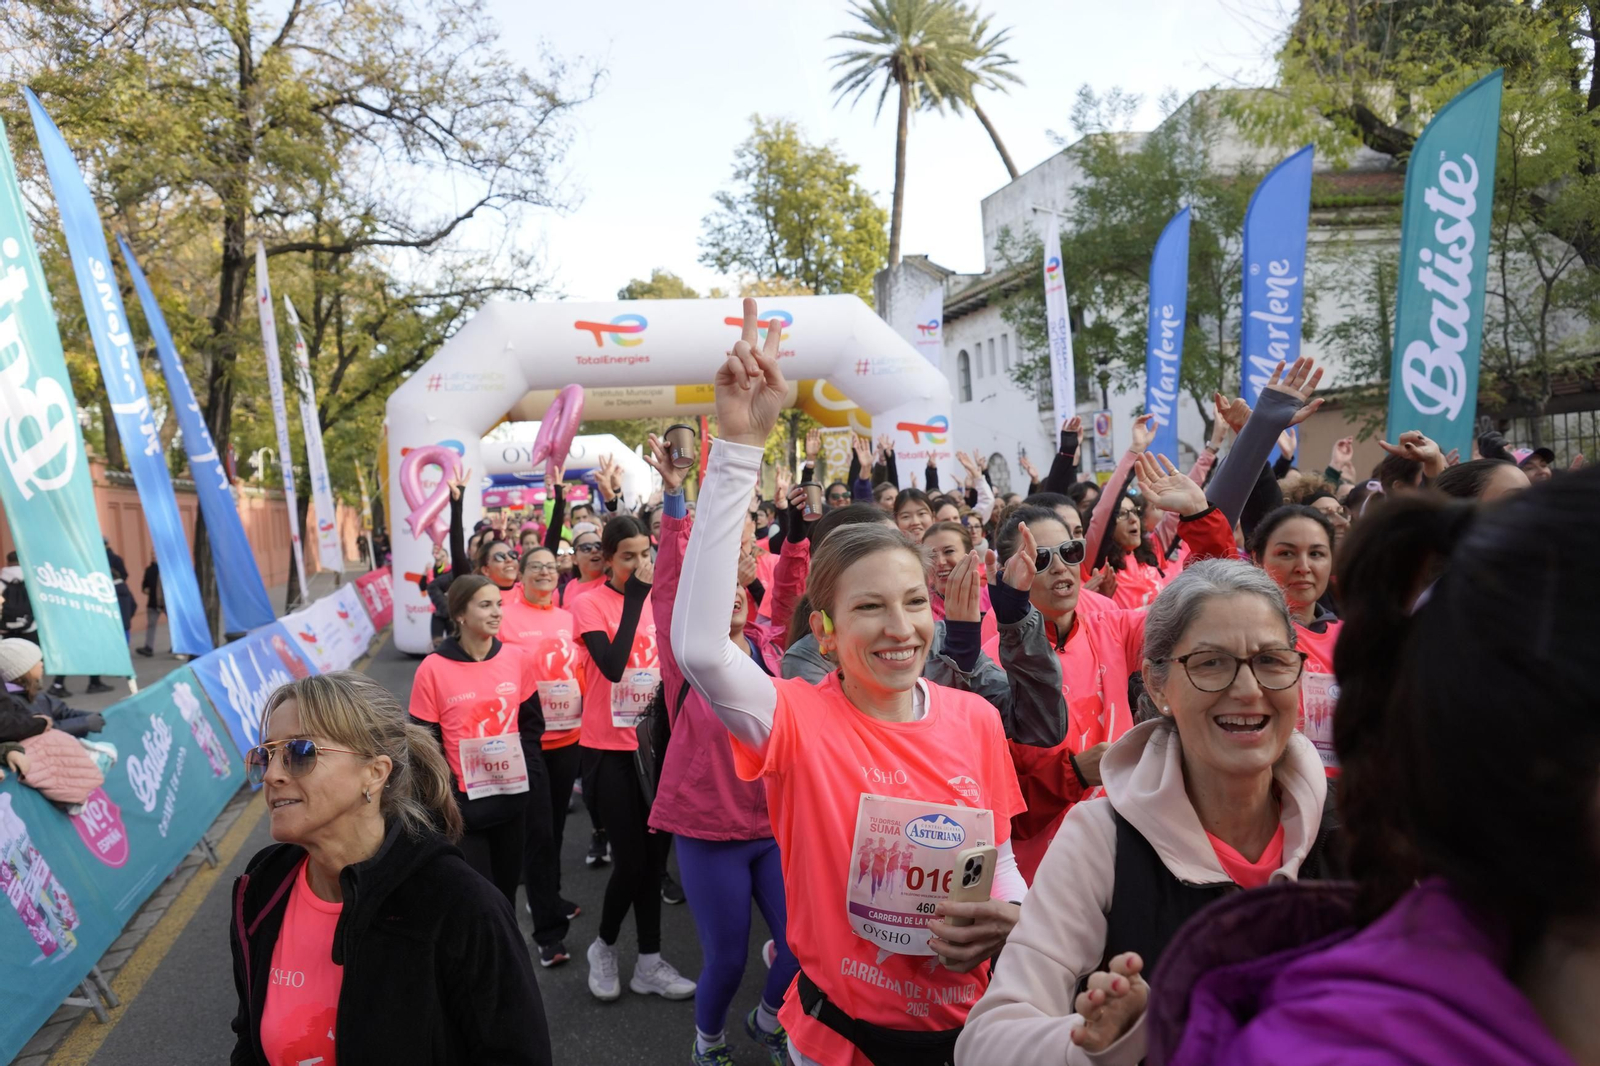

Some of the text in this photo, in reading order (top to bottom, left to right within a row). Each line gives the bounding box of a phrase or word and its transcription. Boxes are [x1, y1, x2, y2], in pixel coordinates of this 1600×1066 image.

[1402, 152, 1479, 421] Batiste
[575, 354, 651, 365] TotalEnergies
[1150, 304, 1181, 427] Marlene
[503, 445, 585, 464] OYO
[447, 692, 476, 704] OYSHO
[550, 701, 570, 710] 016
[633, 693, 654, 703] 016
[484, 760, 510, 772] 016
[861, 766, 907, 785] YSHO
[870, 823, 901, 836] SUMA
[878, 817, 901, 827] DORSAL
[910, 823, 962, 842] ASTURIANA
[868, 910, 902, 924] CARRERA
[904, 916, 913, 925] DE
[915, 917, 924, 926] LA
[863, 923, 911, 946] OYSHO
[268, 967, 305, 988] SHO
[904, 980, 923, 999] DE
[941, 983, 977, 1005] MUJER
[905, 1002, 930, 1017] 2025
